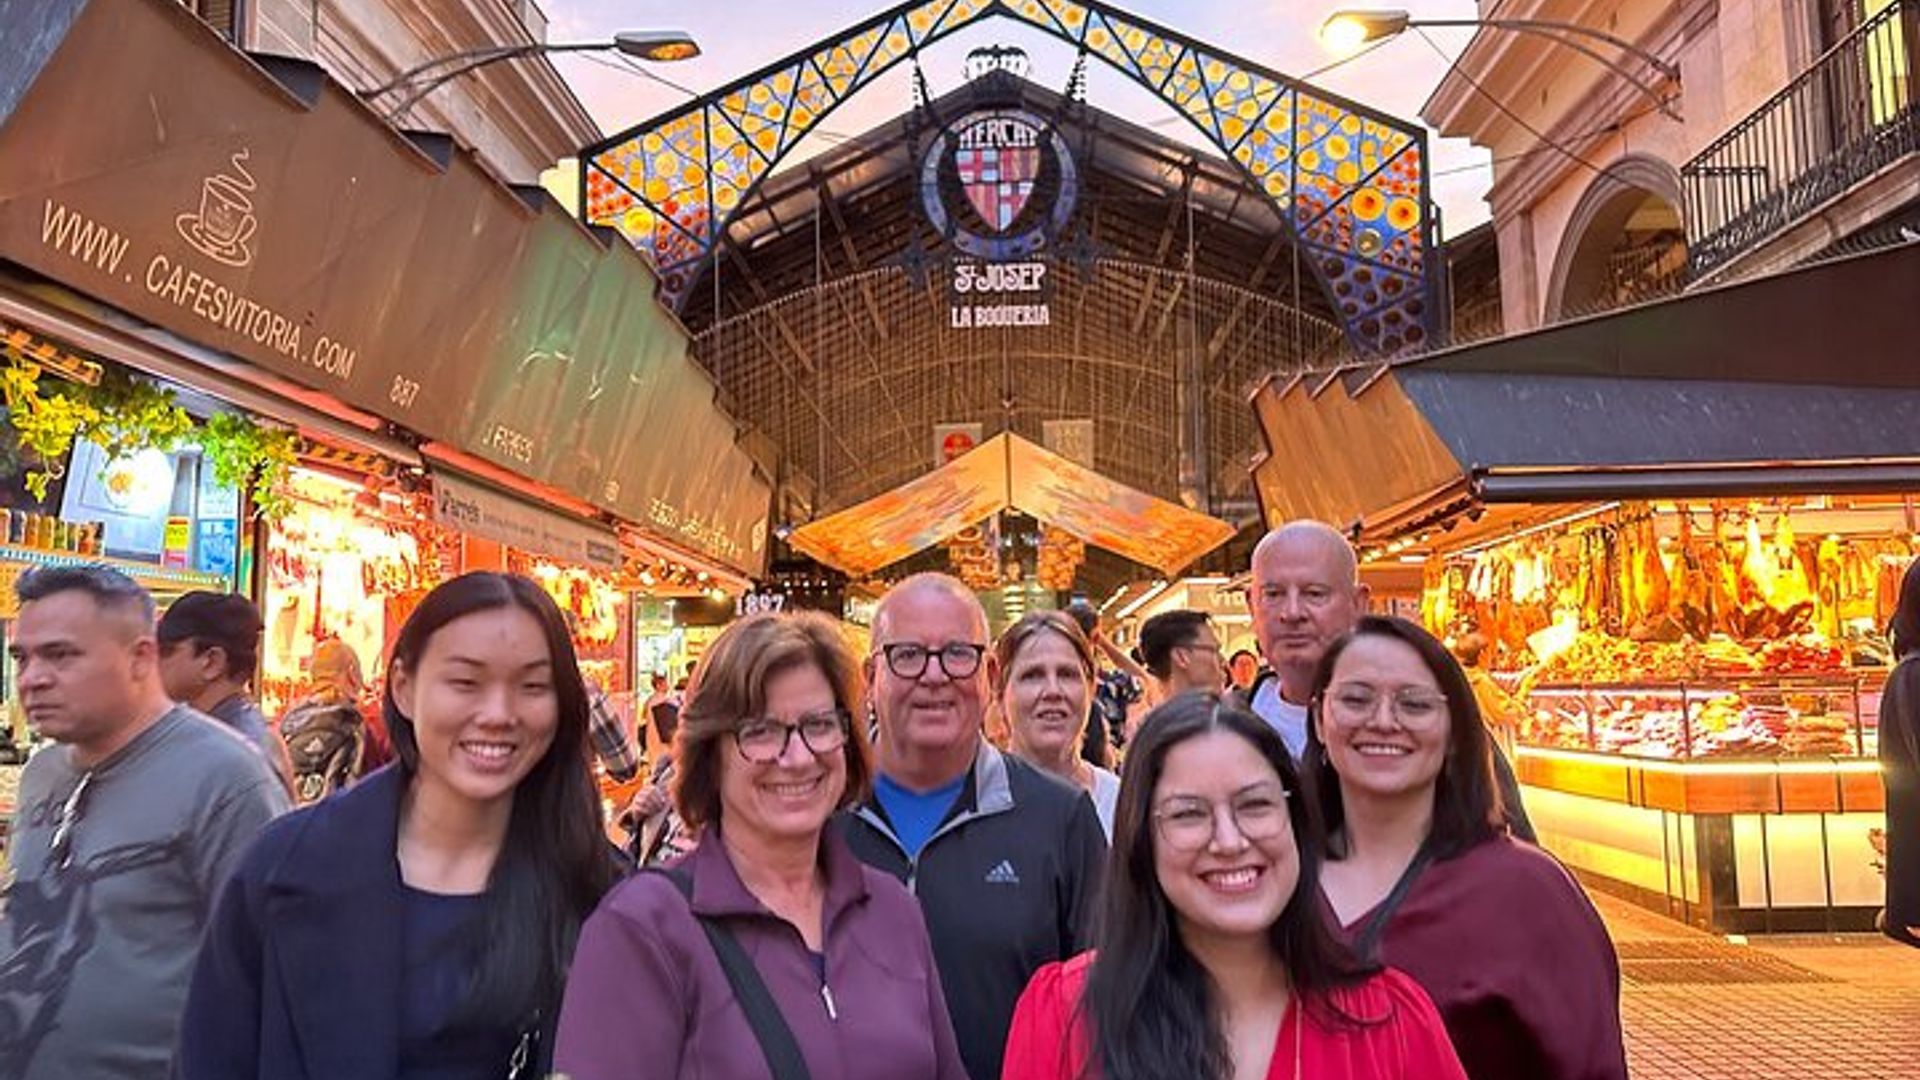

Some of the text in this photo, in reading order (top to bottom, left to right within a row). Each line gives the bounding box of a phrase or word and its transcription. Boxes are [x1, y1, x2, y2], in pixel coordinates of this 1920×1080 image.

[959, 118, 1039, 148] MERCAT
[41, 199, 130, 275] WWW
[145, 255, 303, 361] CAFESVITORIA
[312, 336, 356, 380] COM
[976, 262, 1047, 291] JOSEP
[951, 304, 1050, 328] LA BOQUERIA
[389, 374, 420, 408] 887
[735, 593, 785, 616] 1897
